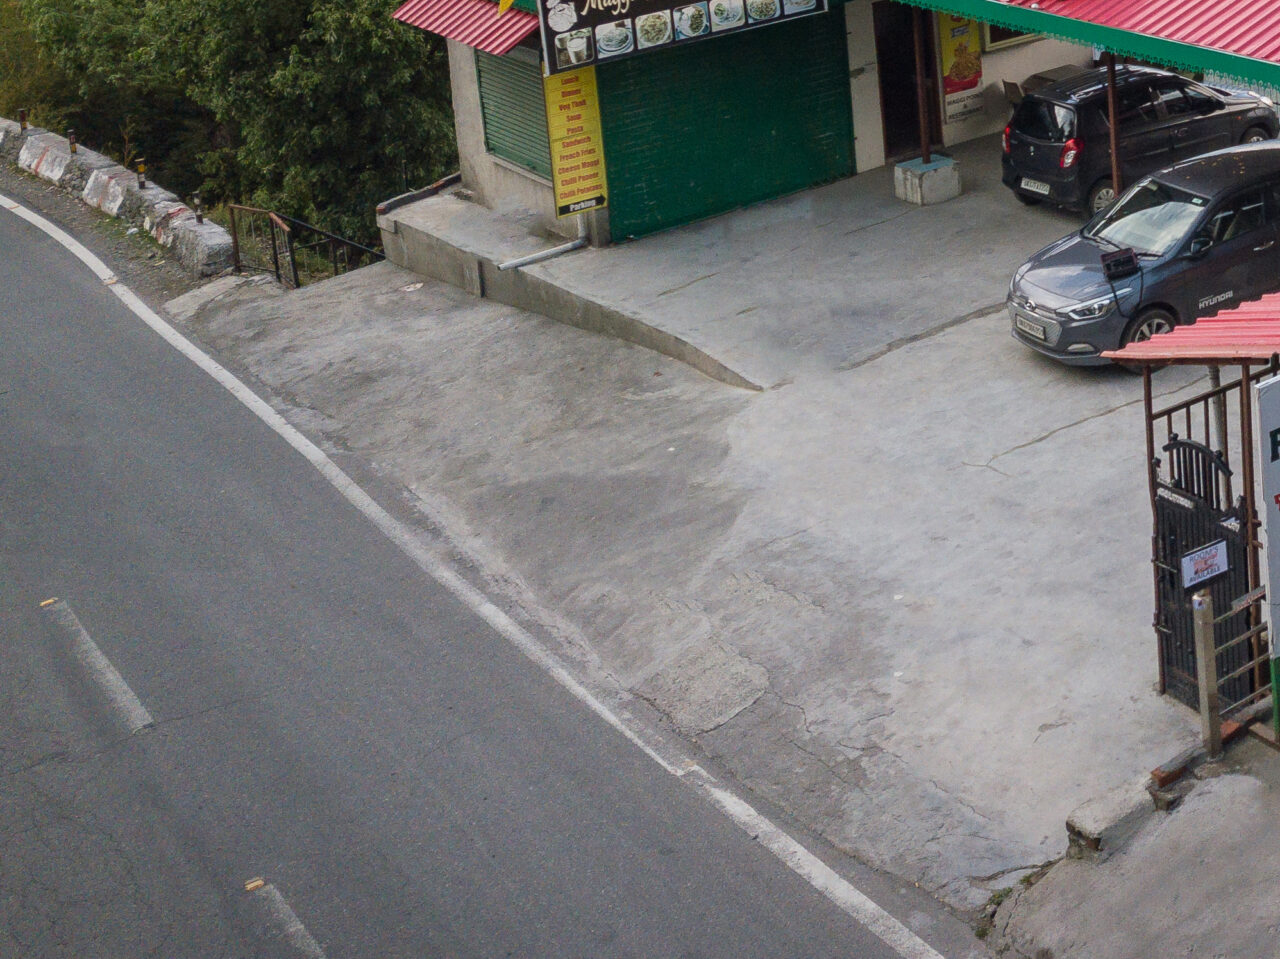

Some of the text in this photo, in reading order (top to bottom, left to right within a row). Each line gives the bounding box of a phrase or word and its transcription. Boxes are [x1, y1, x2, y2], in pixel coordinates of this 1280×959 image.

[569, 199, 597, 212] Parking
[1199, 290, 1233, 309] HYUNDAI
[1189, 566, 1221, 584] AVAILABLE
